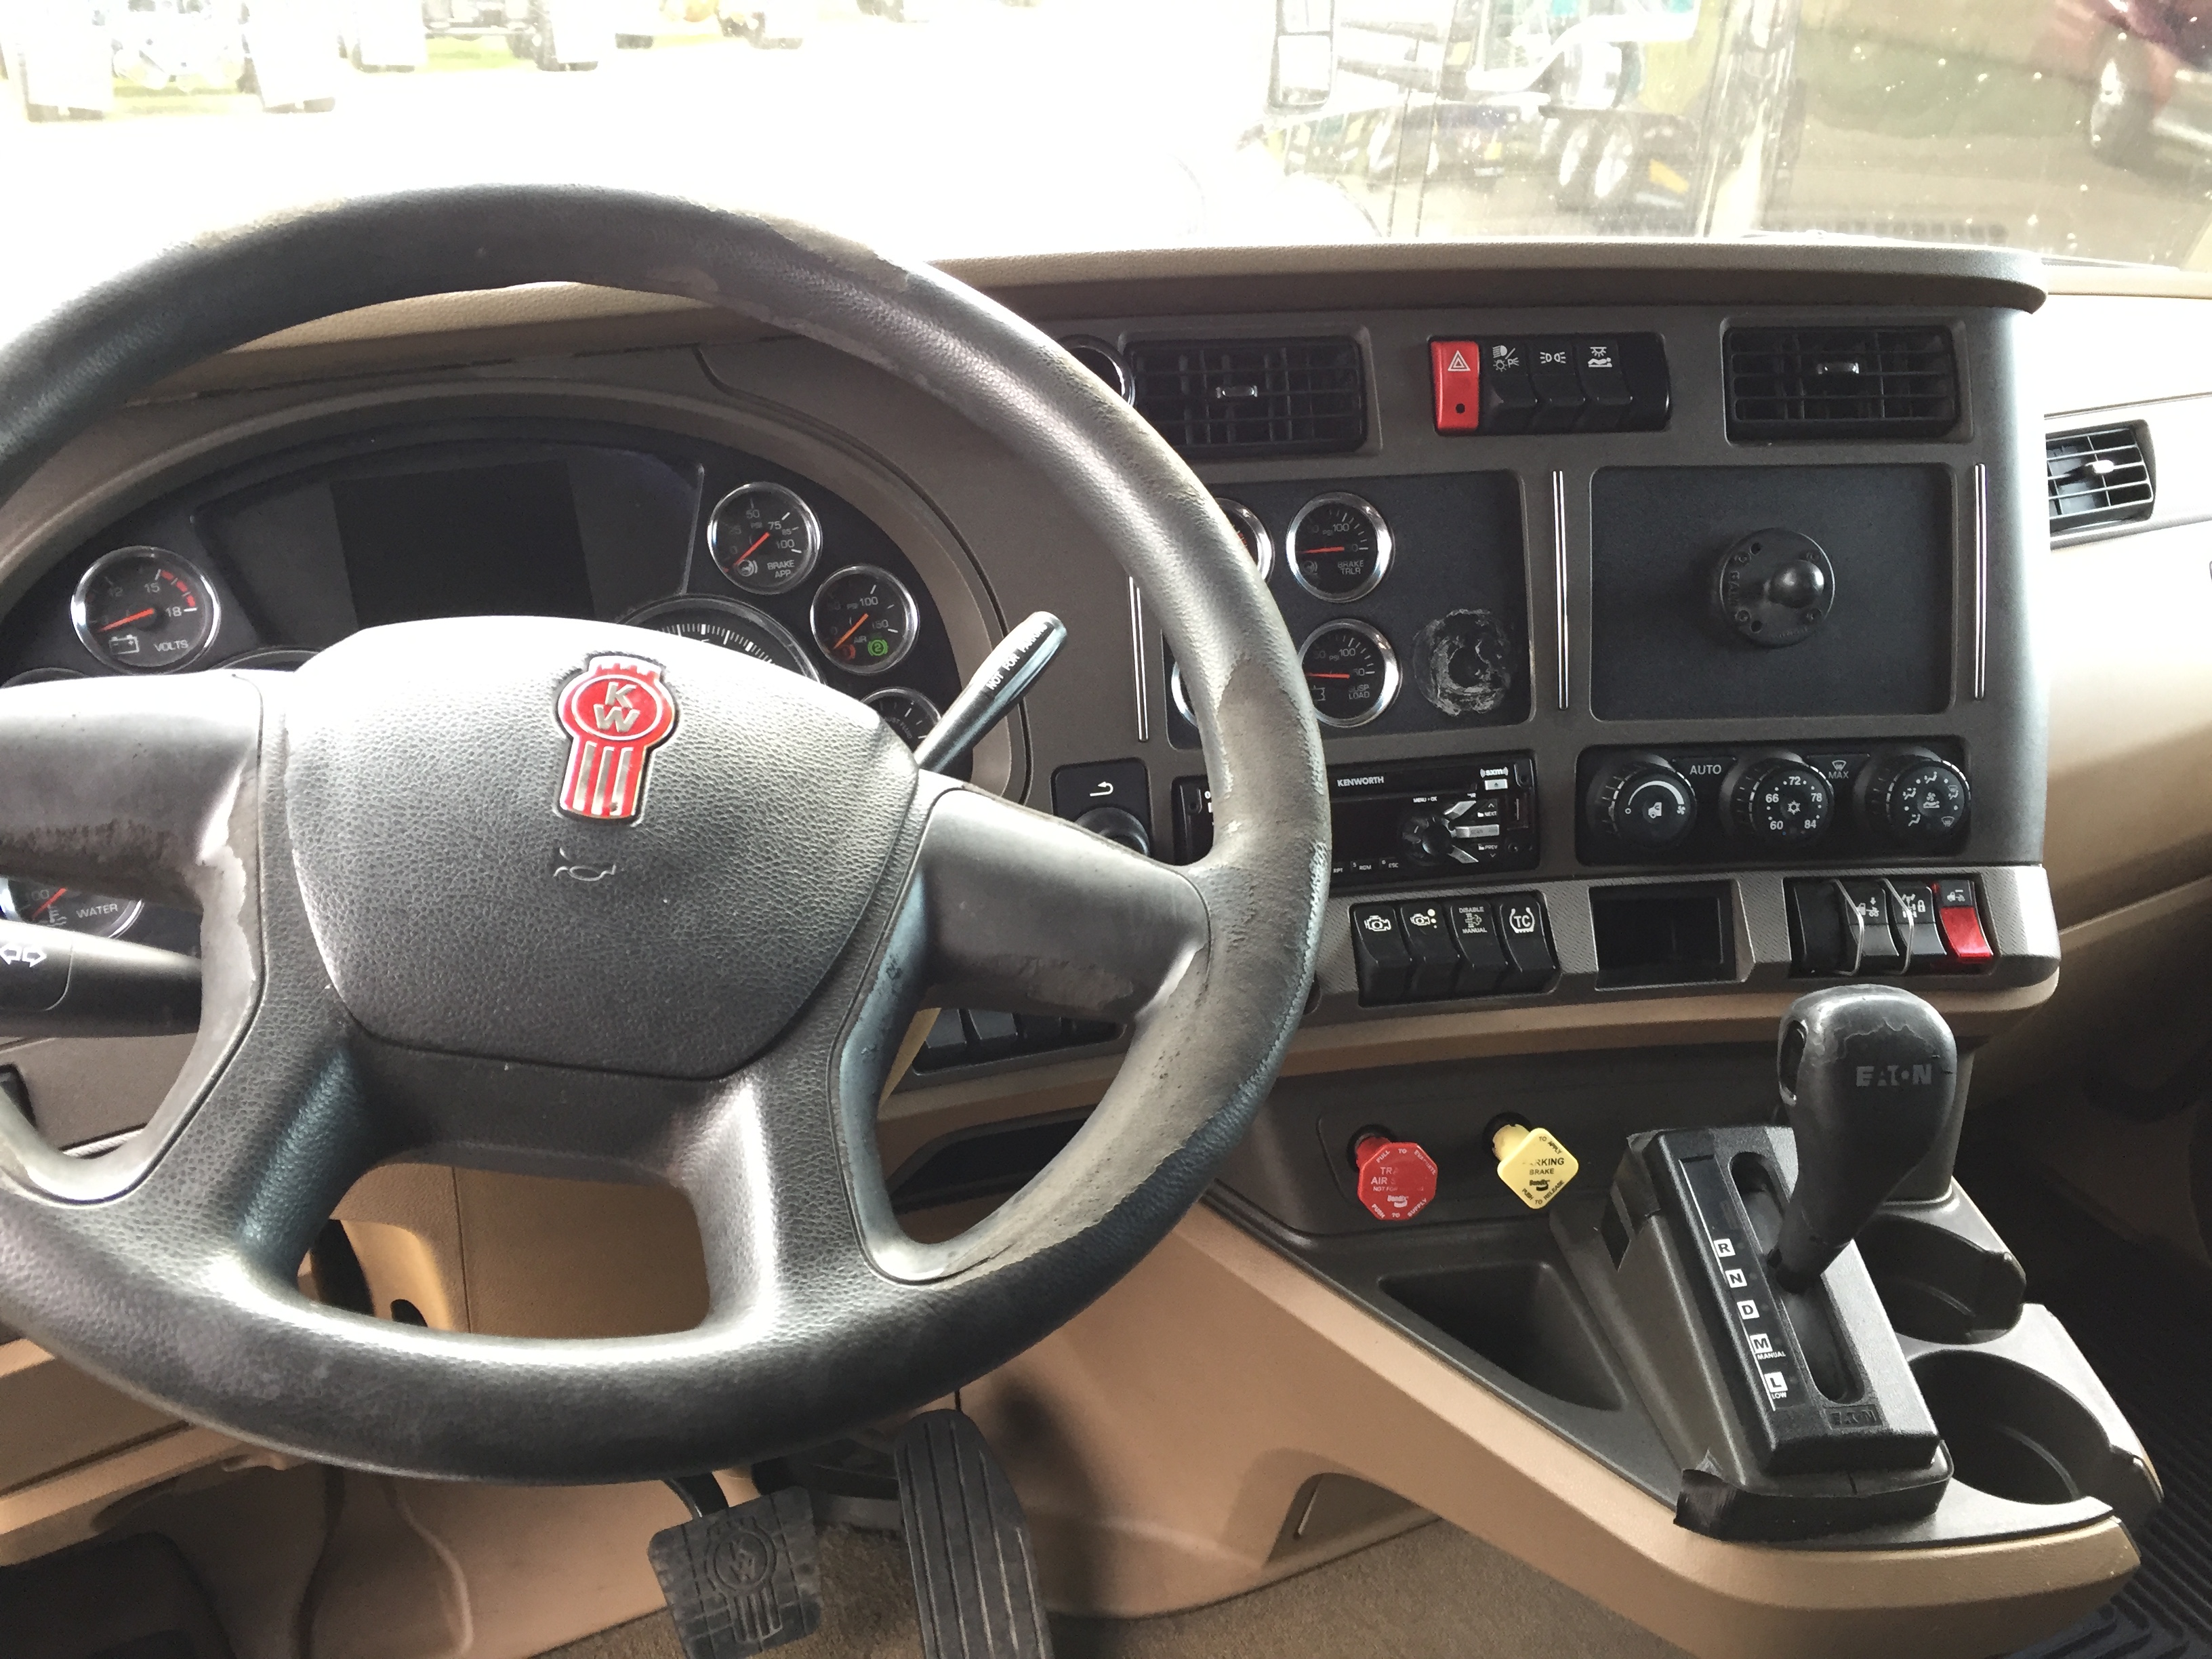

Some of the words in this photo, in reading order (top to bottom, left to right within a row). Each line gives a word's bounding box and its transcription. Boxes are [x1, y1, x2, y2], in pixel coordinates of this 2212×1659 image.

[746, 510, 760, 519] 50
[768, 521, 782, 530] 75
[1332, 523, 1350, 532] 100
[776, 539, 795, 549] 100
[767, 560, 795, 571] BRAKE
[1338, 560, 1364, 568] BRAKE
[775, 569, 792, 578] APP
[144, 583, 160, 593] 15
[859, 596, 878, 607] 100
[166, 606, 182, 617] 18
[872, 619, 888, 629] 150
[853, 636, 867, 644] AIR
[154, 640, 188, 652] VOLTS
[1339, 649, 1355, 657] 100
[986, 671, 1004, 690] NOT
[1002, 653, 1020, 671] FOR
[1349, 691, 1370, 699] LOAD
[1689, 764, 1722, 775] AUTO
[1828, 771, 1849, 779] MAX
[1337, 776, 1384, 787] KENWORTH
[1788, 776, 1801, 785] 72
[1765, 794, 1779, 803] 66
[1811, 793, 1823, 802] 78
[1769, 821, 1784, 830] 60
[1804, 819, 1817, 829] 84
[76, 903, 118, 918] WATER
[1513, 916, 1531, 928] TC
[1856, 1063, 1931, 1087] EATON
[1548, 1141, 1563, 1155] APPLY
[1376, 1150, 1391, 1163] PULL
[1371, 1176, 1387, 1185] AIR
[1522, 1188, 1534, 1200] PUSH
[1543, 1180, 1565, 1200] RELEASE
[1372, 1204, 1386, 1218] PUSH
[1408, 1198, 1427, 1217] SUPPLY
[1718, 1243, 1732, 1254] R
[1729, 1273, 1744, 1284] N
[1742, 1304, 1755, 1315] D
[1753, 1337, 1770, 1349] M
[1757, 1351, 1786, 1360] MANUAL
[1769, 1376, 1782, 1388] L
